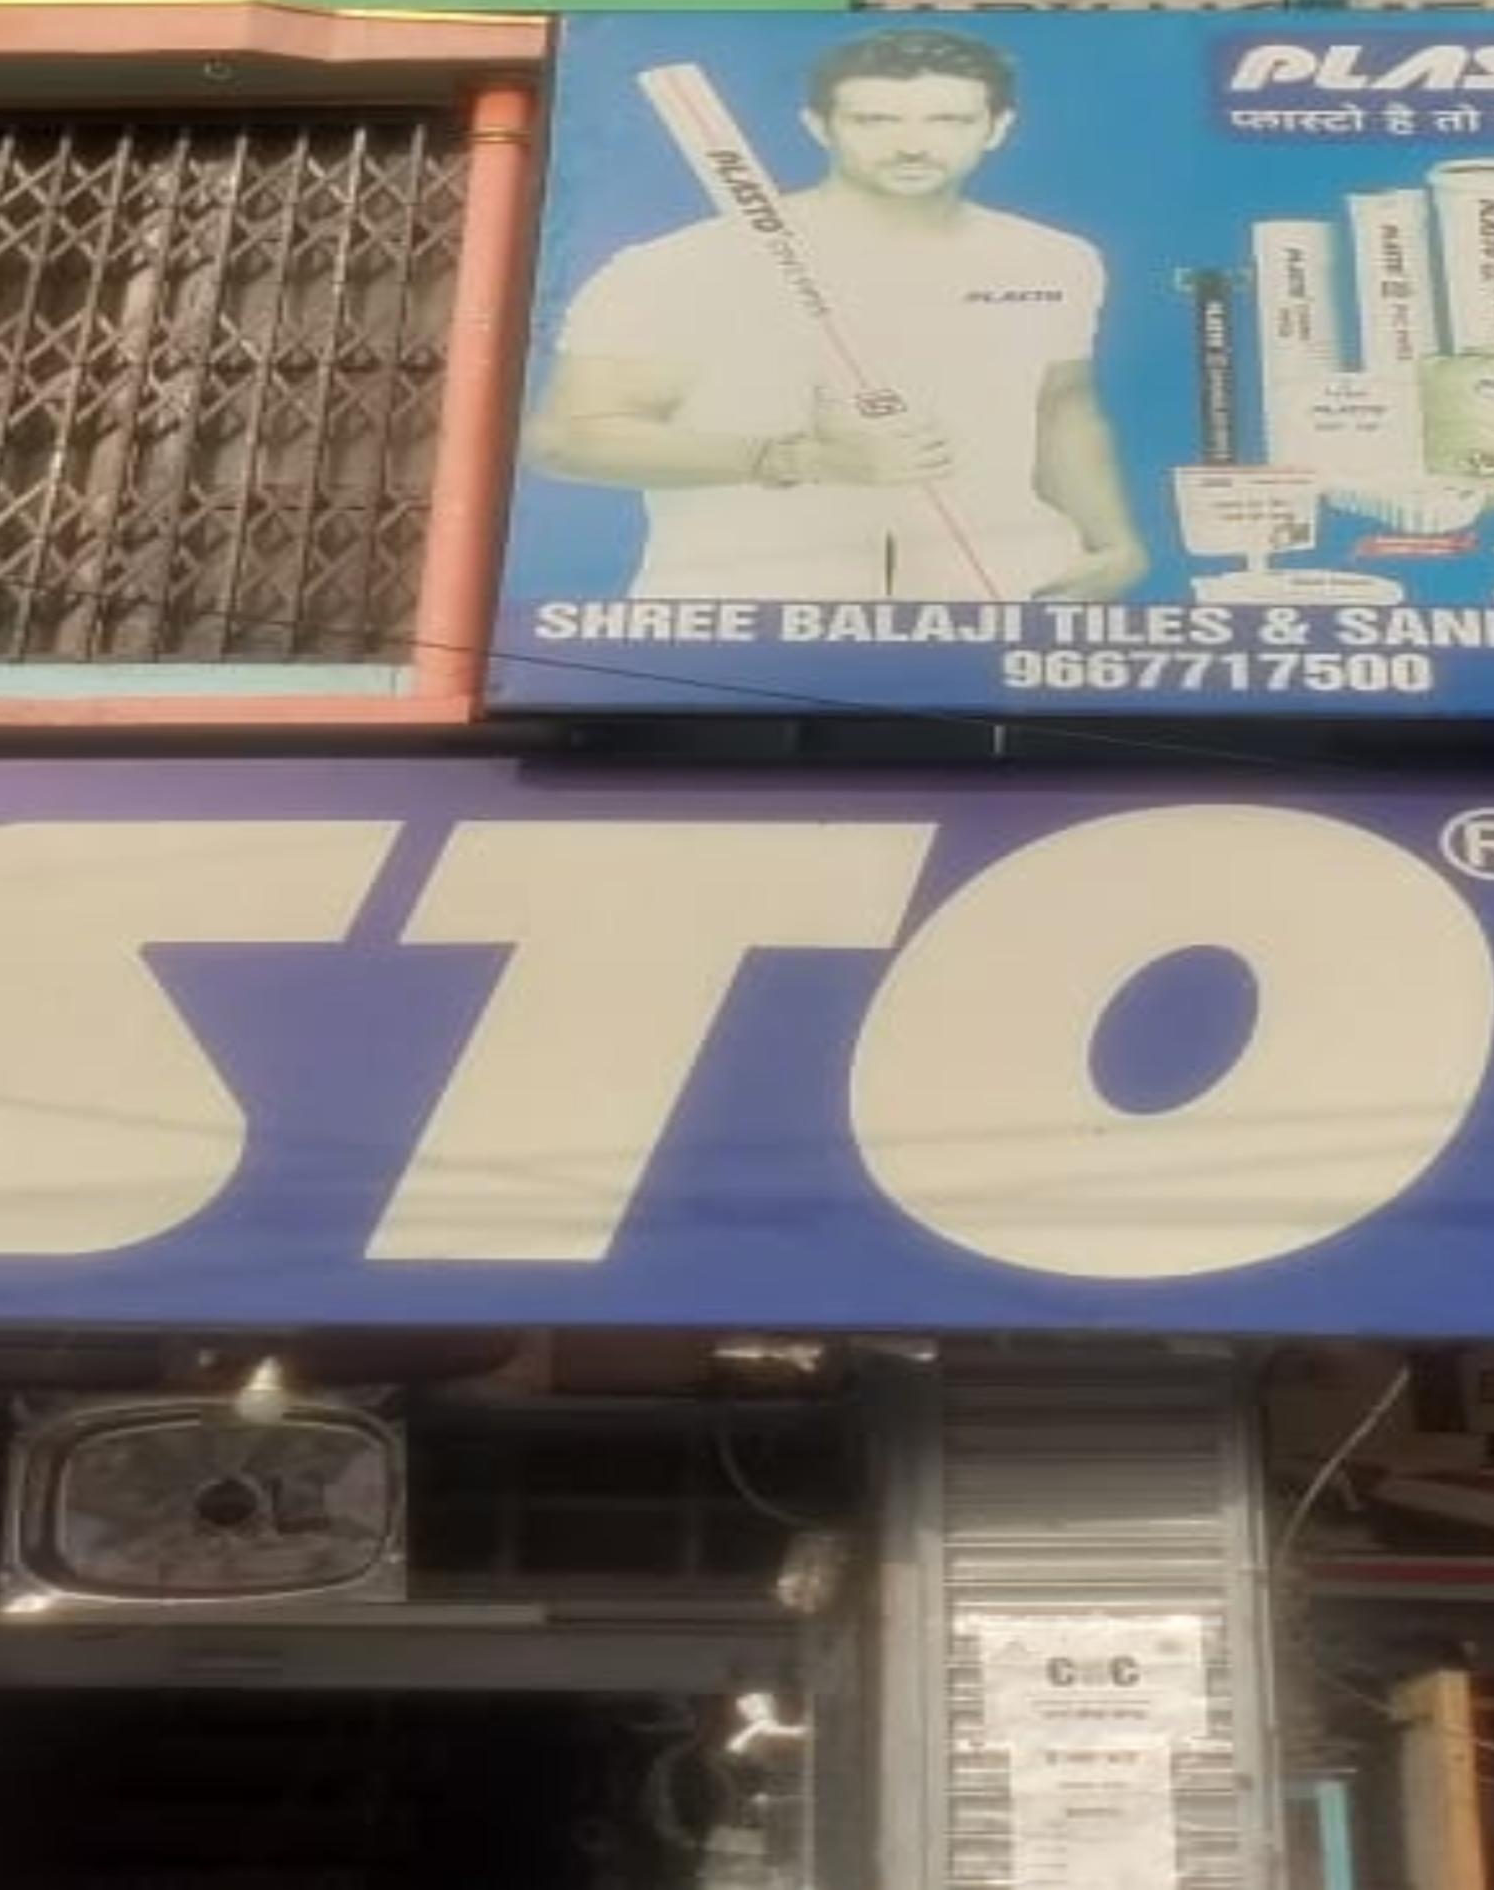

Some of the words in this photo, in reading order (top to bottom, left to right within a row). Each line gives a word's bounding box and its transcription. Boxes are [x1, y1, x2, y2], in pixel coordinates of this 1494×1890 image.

[1382, 101, 1417, 136] है
[1432, 102, 1481, 132] तो
[706, 148, 783, 234] PLASTO
[534, 603, 757, 640] SHREE
[780, 604, 1023, 643] BALAJI
[1045, 606, 1233, 645] TILES
[1259, 607, 1308, 645] &
[1003, 650, 1433, 692] 9667717500
